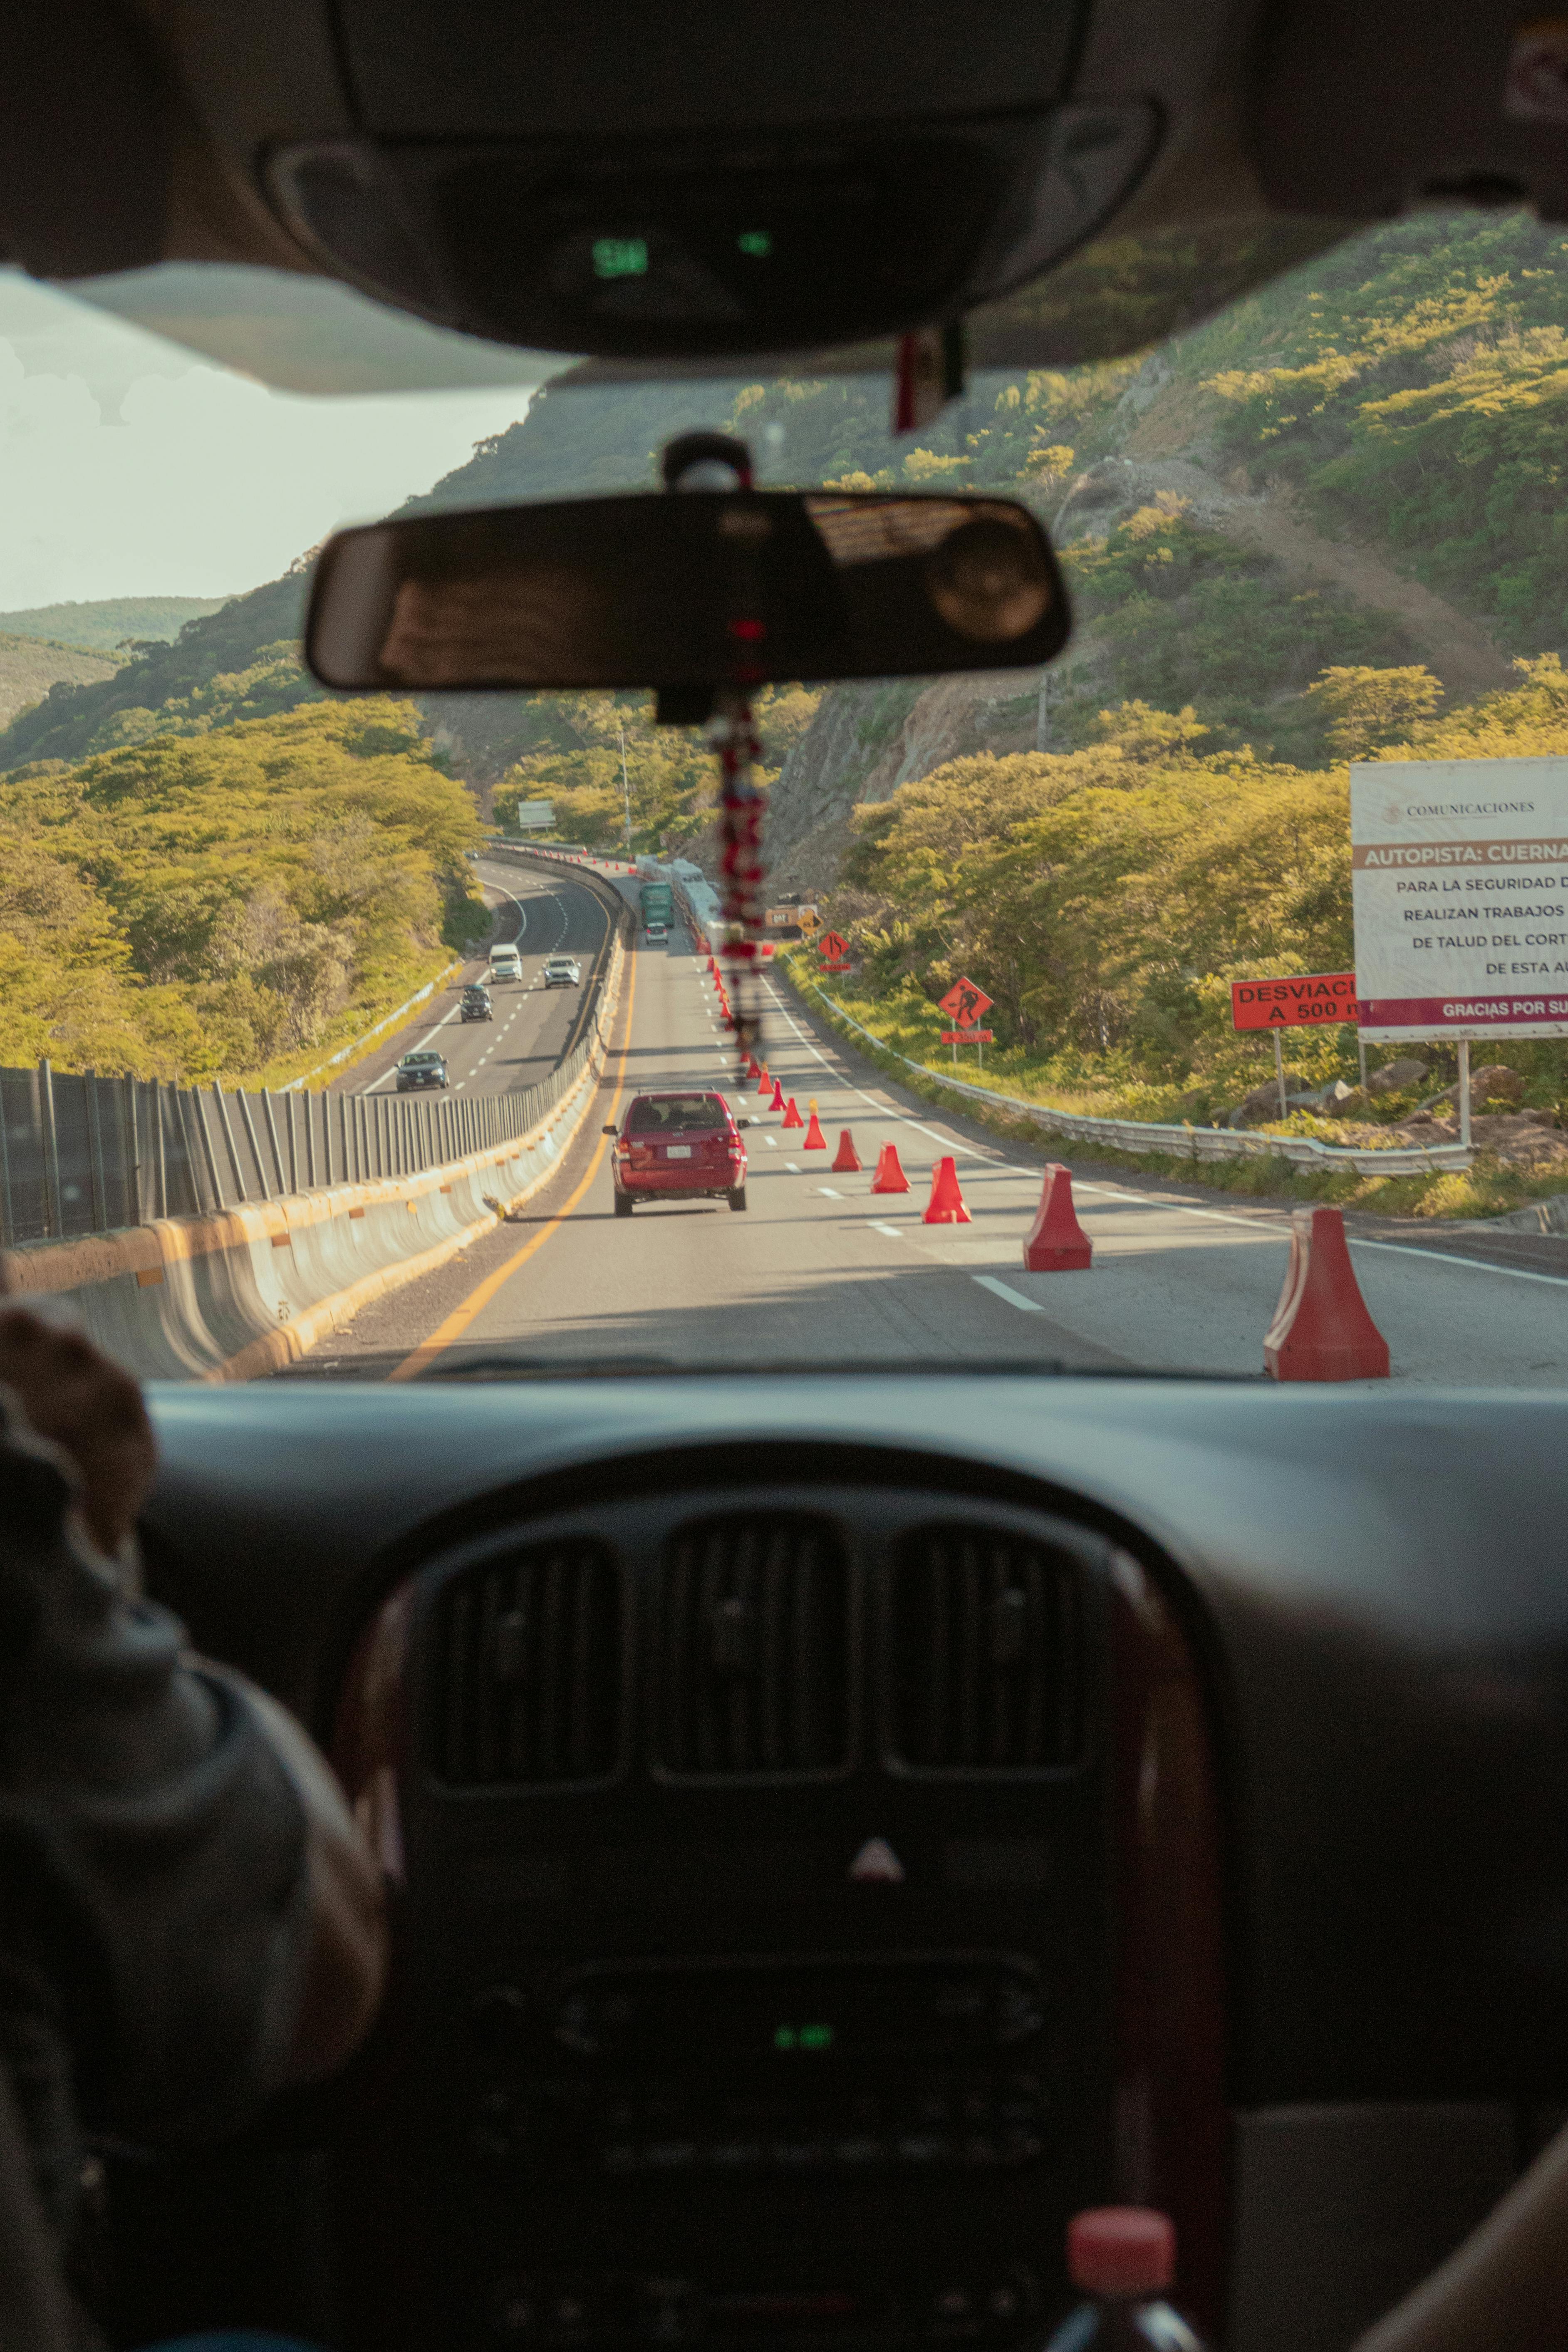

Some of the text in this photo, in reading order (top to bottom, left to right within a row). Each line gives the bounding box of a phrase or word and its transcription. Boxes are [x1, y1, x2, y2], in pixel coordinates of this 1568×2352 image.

[1407, 802, 1535, 817] COMUNICACIONES
[1365, 846, 1482, 866] AUTOPISTA:
[1397, 880, 1439, 893] PARA
[1443, 880, 1461, 891] LA
[1465, 877, 1556, 891] SEGURIDAD
[1404, 905, 1564, 921] REALIZAN TRABAJOS
[1413, 933, 1568, 949] DE TALUD DEL CORT
[1486, 962, 1568, 974] DE ESTA A
[1239, 980, 1355, 1004] DESVIACI
[1269, 1006, 1286, 1021] A
[1297, 1001, 1337, 1019] 500
[1443, 1000, 1568, 1017] GRACIAS POR SU
